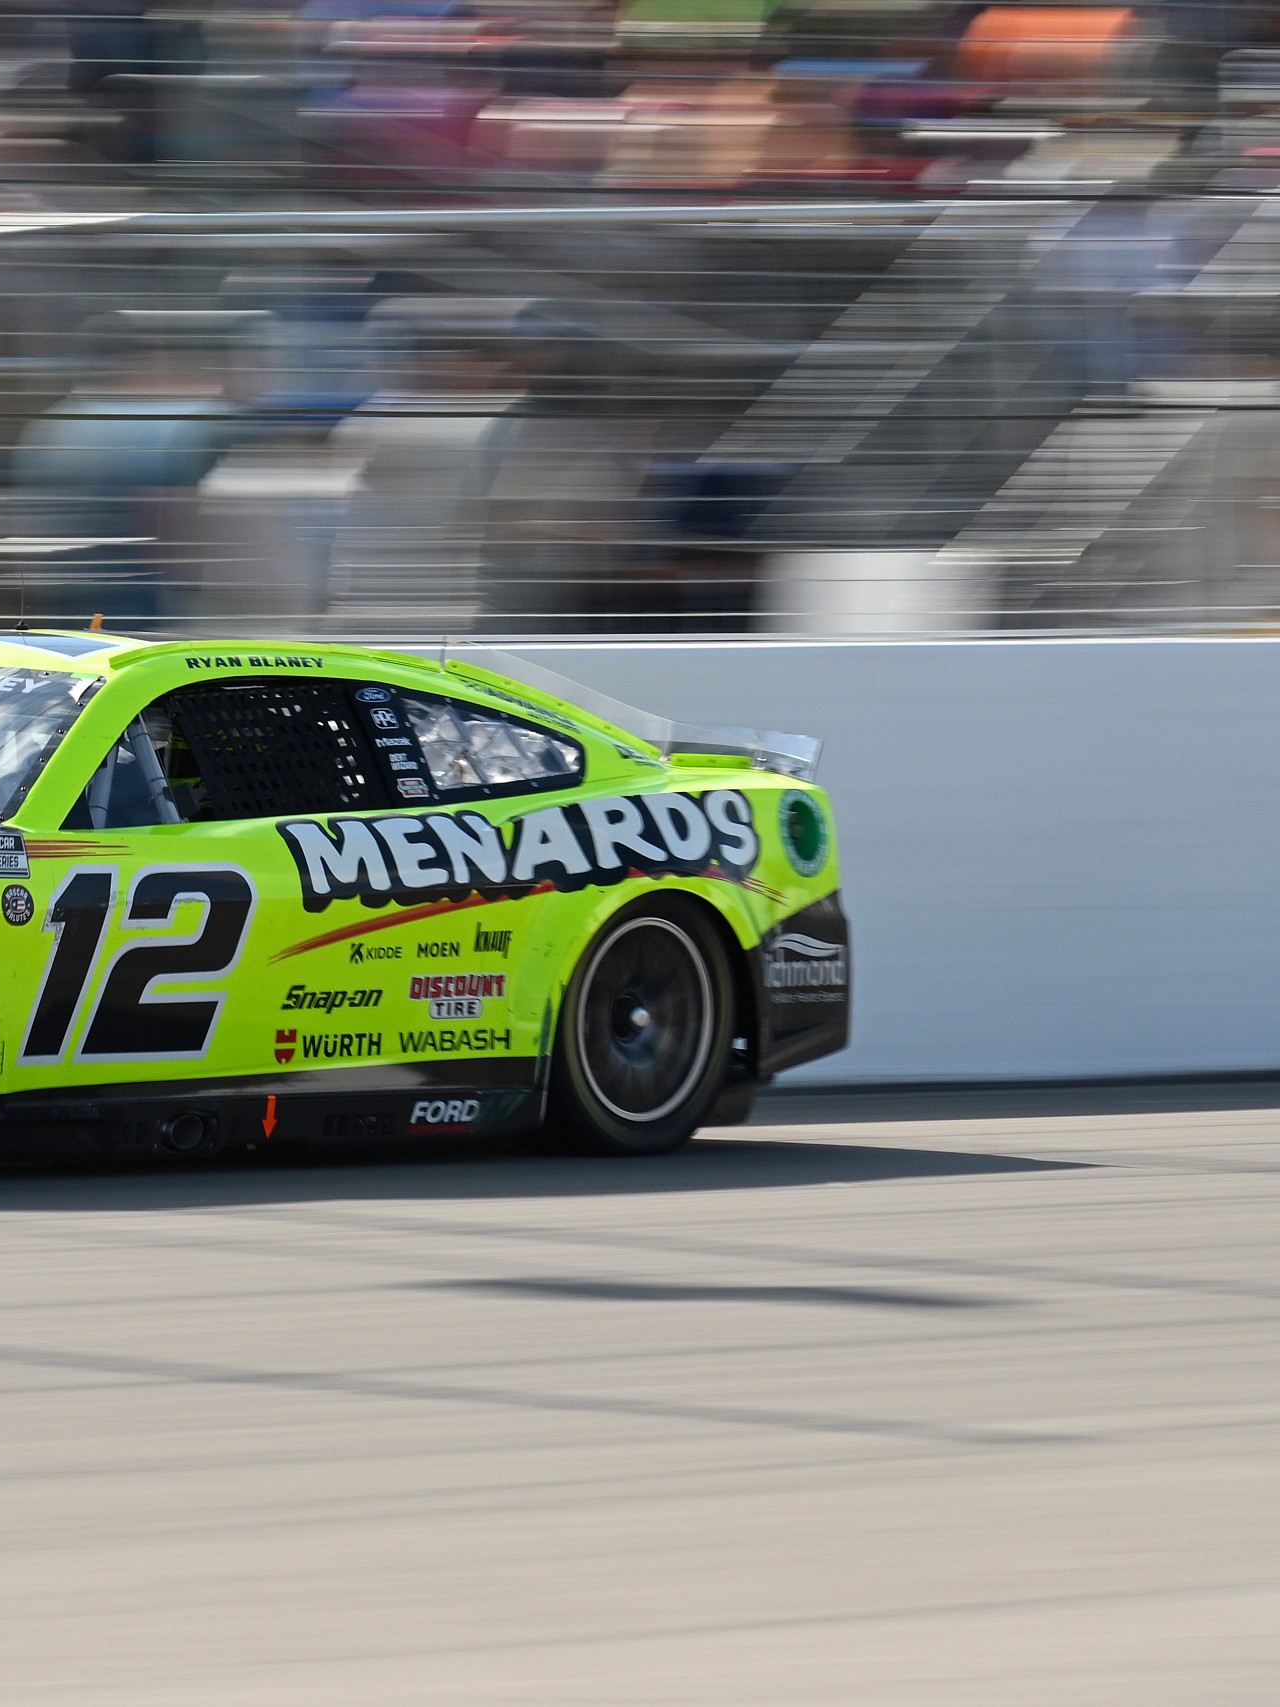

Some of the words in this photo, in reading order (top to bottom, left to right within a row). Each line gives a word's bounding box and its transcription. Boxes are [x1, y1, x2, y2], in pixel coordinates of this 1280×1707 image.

[185, 656, 243, 669] RYAN
[247, 656, 324, 669] BLANEY
[362, 689, 386, 701] Ford
[282, 788, 758, 897] MENARDS
[5, 888, 28, 901] NASCAR
[6, 909, 31, 922] SALUTES
[417, 942, 460, 958] MOEN
[474, 921, 513, 959] KNAUF
[366, 946, 402, 959] KIDDE
[19, 867, 255, 1062] 12
[410, 974, 505, 999] DISCOUNT
[281, 984, 384, 1014] Snap-on
[435, 1001, 477, 1016] TIRE
[398, 1028, 512, 1053] WABASH
[410, 1099, 480, 1124] FORD
